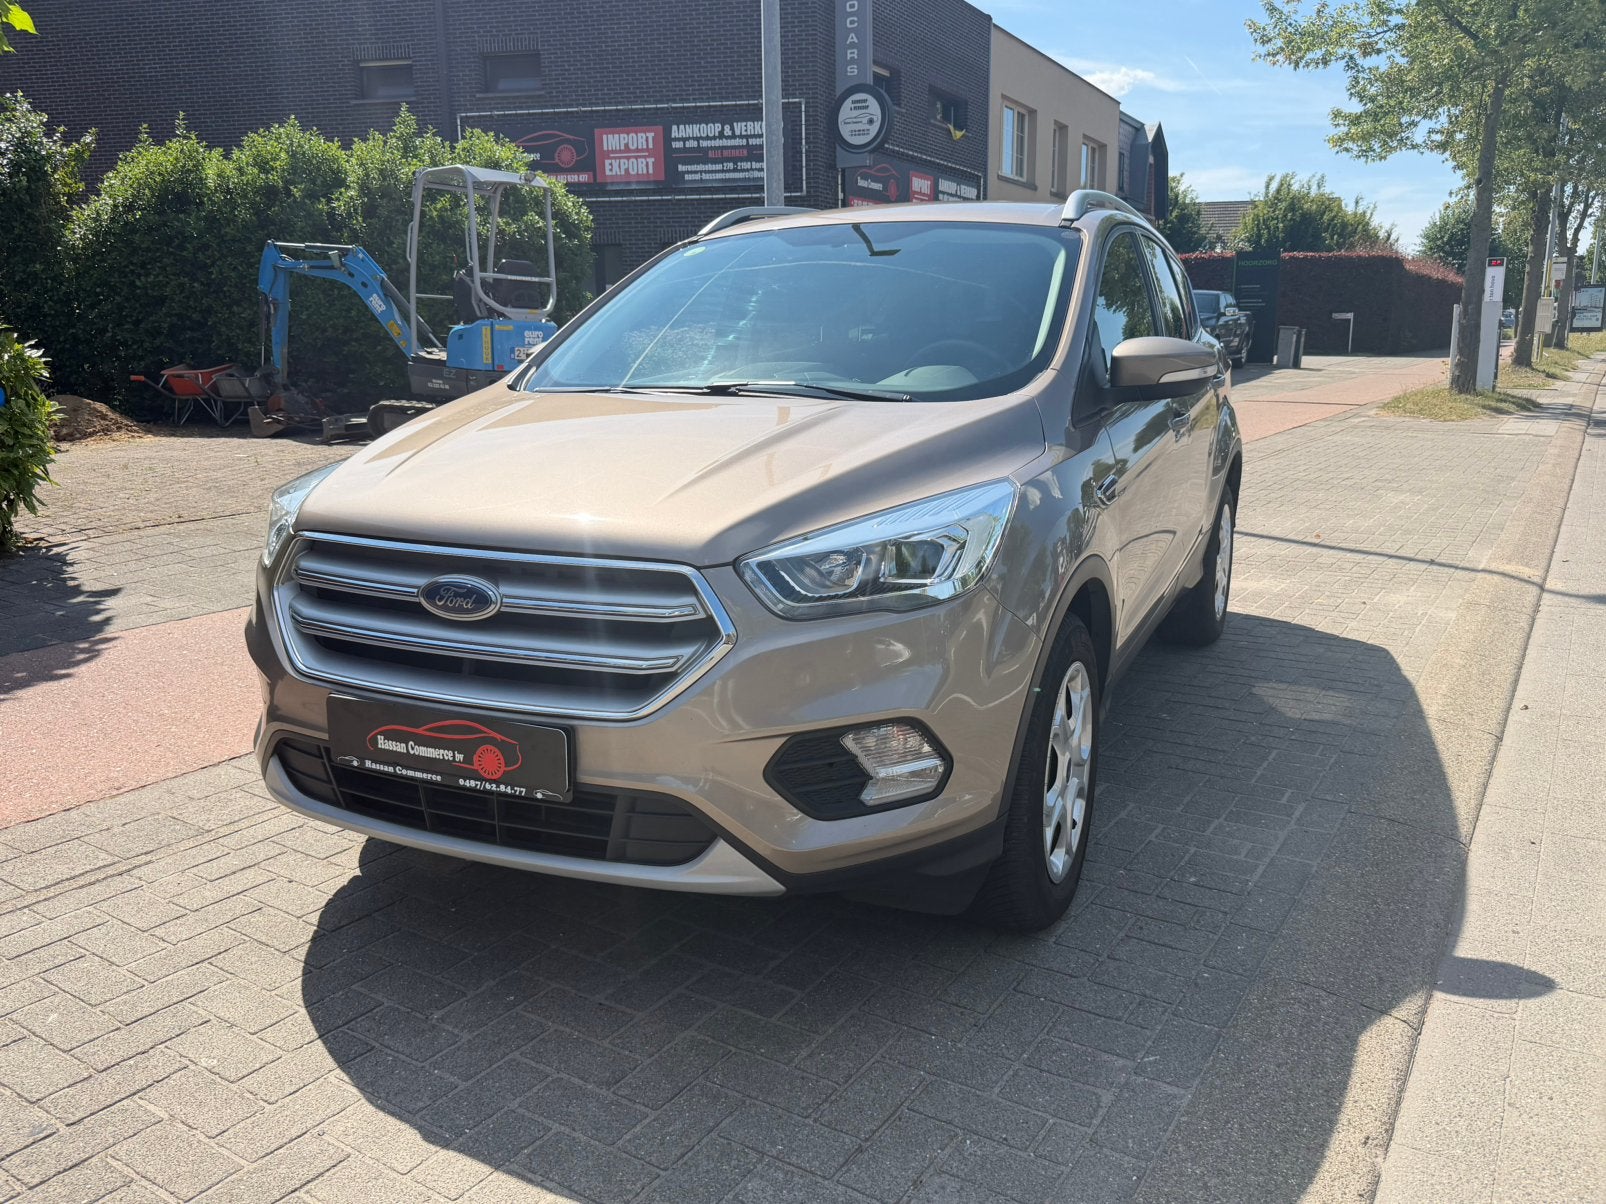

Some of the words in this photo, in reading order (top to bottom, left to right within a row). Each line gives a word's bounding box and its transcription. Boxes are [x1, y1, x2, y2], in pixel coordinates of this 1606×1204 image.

[671, 123, 722, 138] AANKOOP
[723, 124, 732, 136] &
[603, 133, 655, 150] IMPORT
[671, 141, 684, 149] van
[685, 139, 698, 148] alle
[699, 138, 747, 148] tweedehandse
[604, 157, 655, 176] EXPORT
[912, 176, 931, 194] IMPORT
[524, 330, 544, 338] euro
[435, 585, 477, 609] Ford
[377, 735, 407, 754] Hassan
[408, 741, 454, 761] Commerce
[454, 750, 465, 763] bv
[364, 759, 394, 773] Hassan
[395, 765, 442, 782] Commerce
[458, 778, 526, 795] 0487/62.84.77
